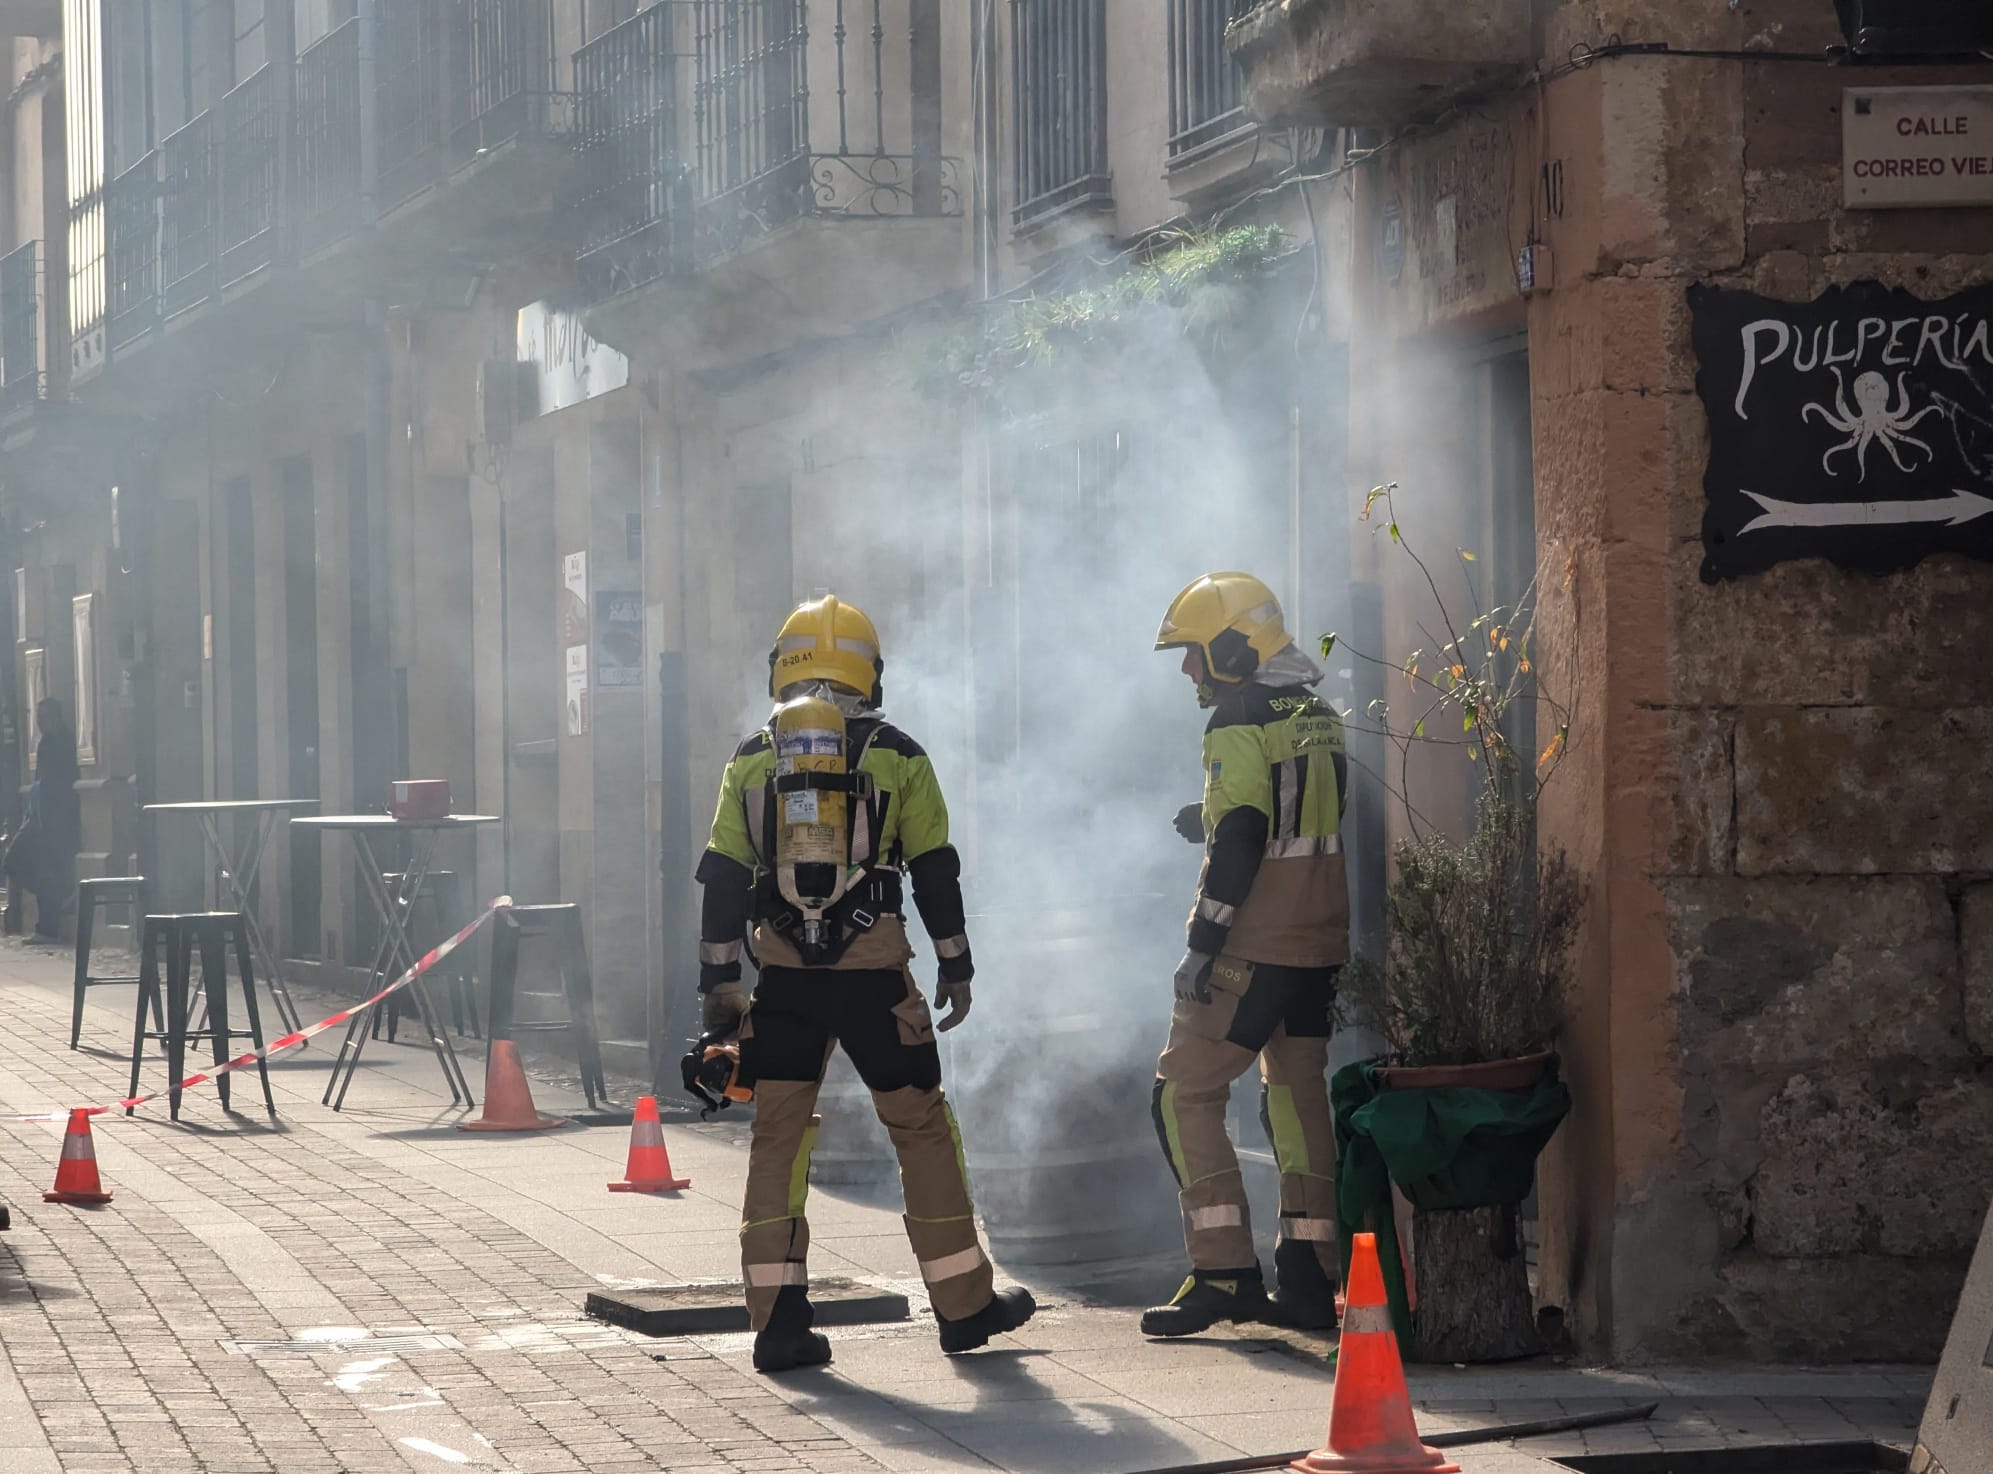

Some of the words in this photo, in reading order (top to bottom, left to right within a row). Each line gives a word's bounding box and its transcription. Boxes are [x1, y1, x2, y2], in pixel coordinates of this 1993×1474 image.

[1896, 116, 1968, 136] CALLE
[1853, 157, 1945, 178] CORREO
[1543, 159, 1564, 219] 10
